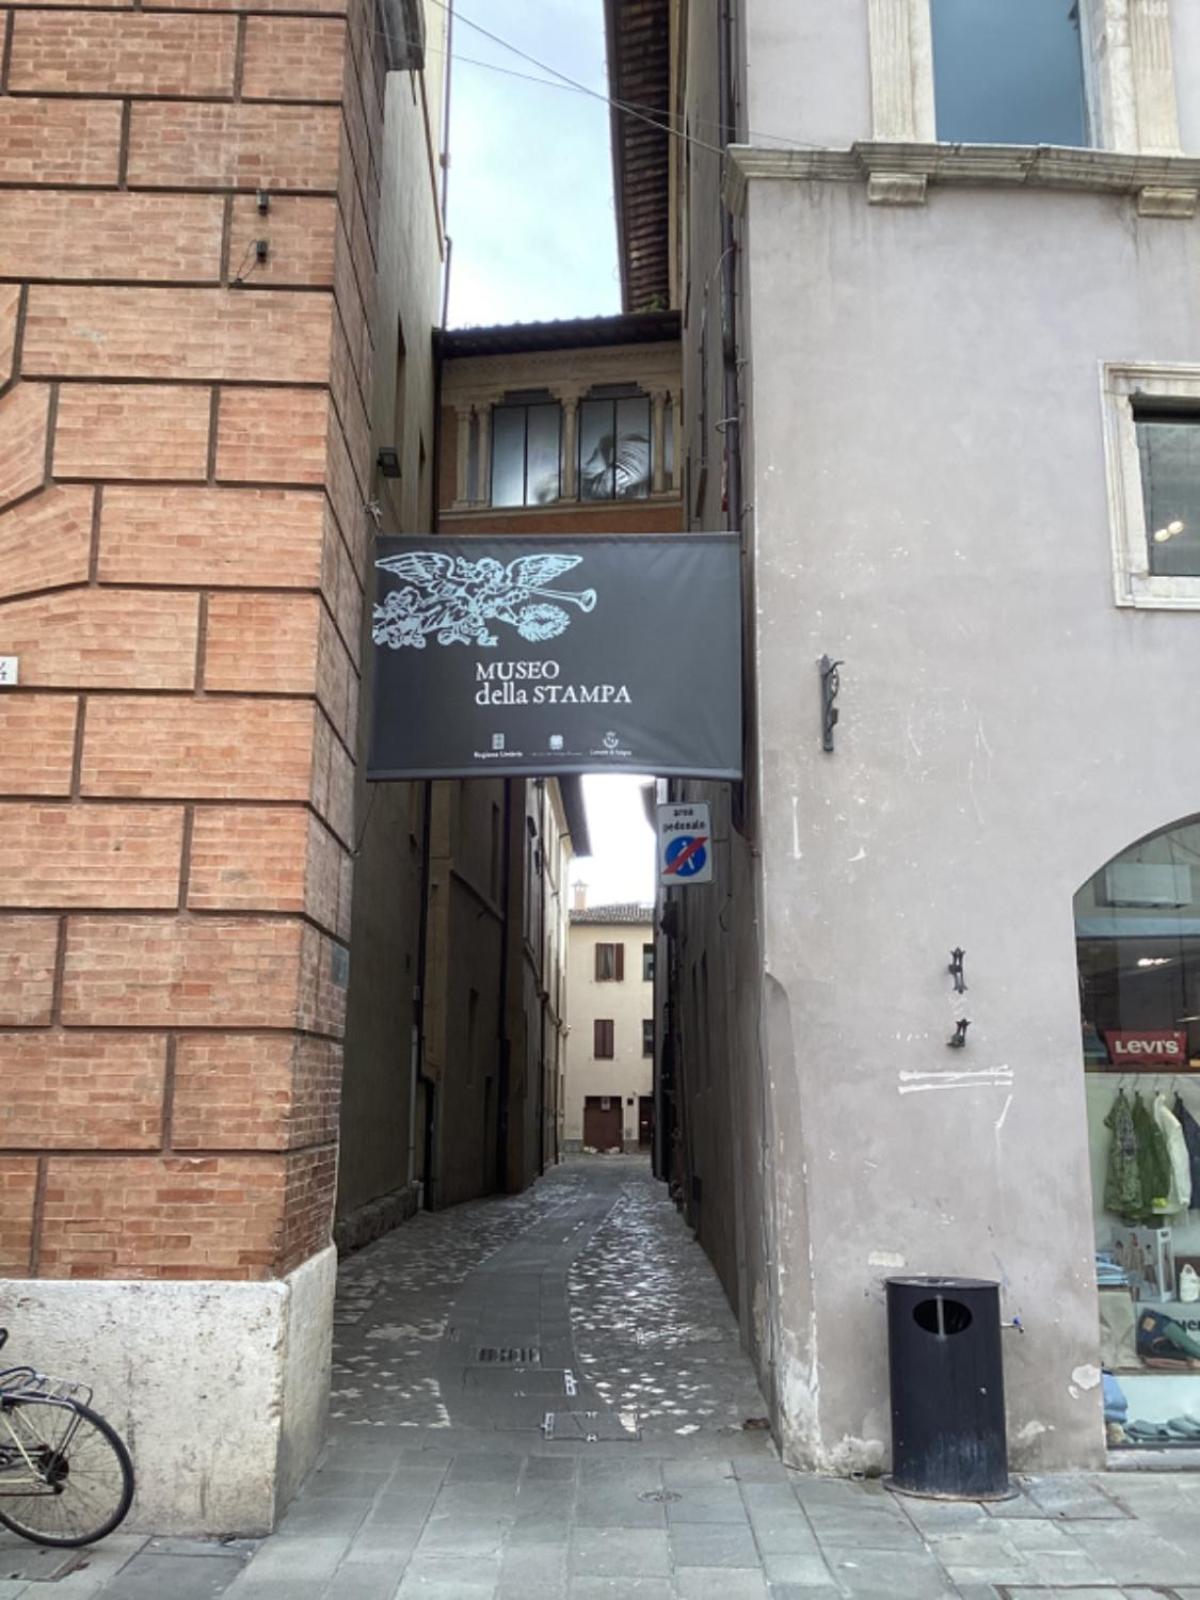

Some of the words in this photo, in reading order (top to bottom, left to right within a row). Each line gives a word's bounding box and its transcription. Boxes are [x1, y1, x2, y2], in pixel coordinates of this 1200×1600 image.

[475, 660, 560, 681] MUSEO
[475, 681, 528, 705] della
[532, 684, 633, 704] STAMPA
